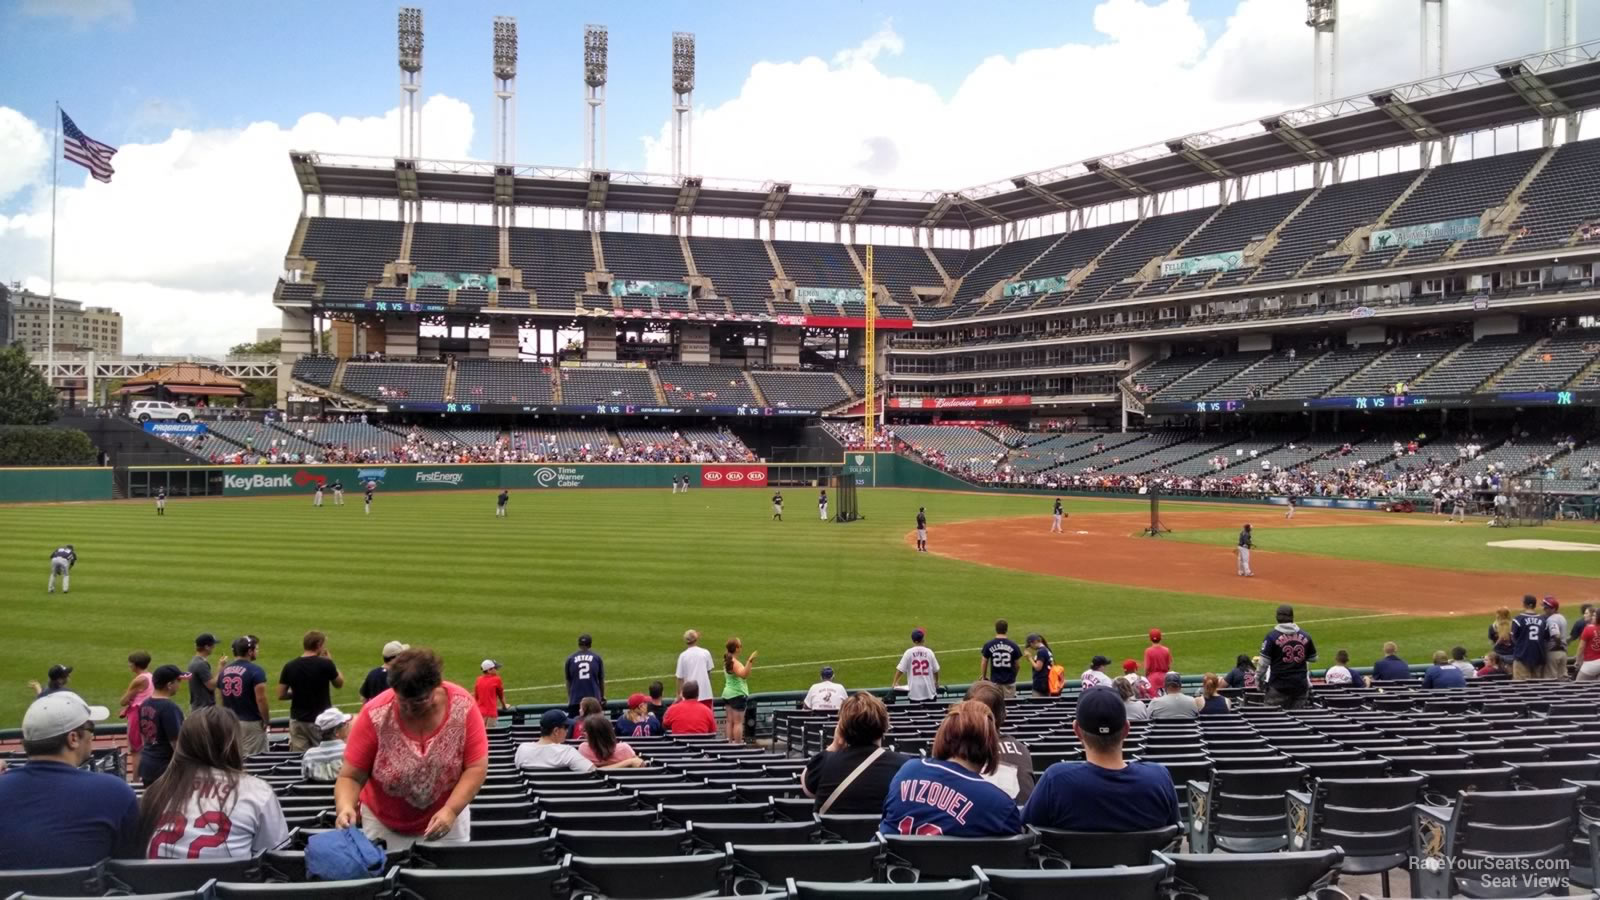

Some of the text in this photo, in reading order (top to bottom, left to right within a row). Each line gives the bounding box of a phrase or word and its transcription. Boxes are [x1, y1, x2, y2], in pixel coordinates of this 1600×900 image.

[935, 397, 977, 408] Budweiser
[1211, 402, 1220, 411] VS
[1373, 398, 1385, 407] VS
[152, 424, 198, 432] PROGRESSIVE
[224, 474, 292, 491] KeyBank
[415, 471, 463, 483] FirstEnergy
[1524, 617, 1543, 626] JETER
[1529, 625, 1539, 641] 2
[992, 652, 1012, 668] 22
[1282, 644, 1305, 664] 33
[578, 662, 590, 680] 2
[912, 659, 930, 676] 22
[222, 676, 243, 697] 33
[998, 741, 1023, 755] IEL
